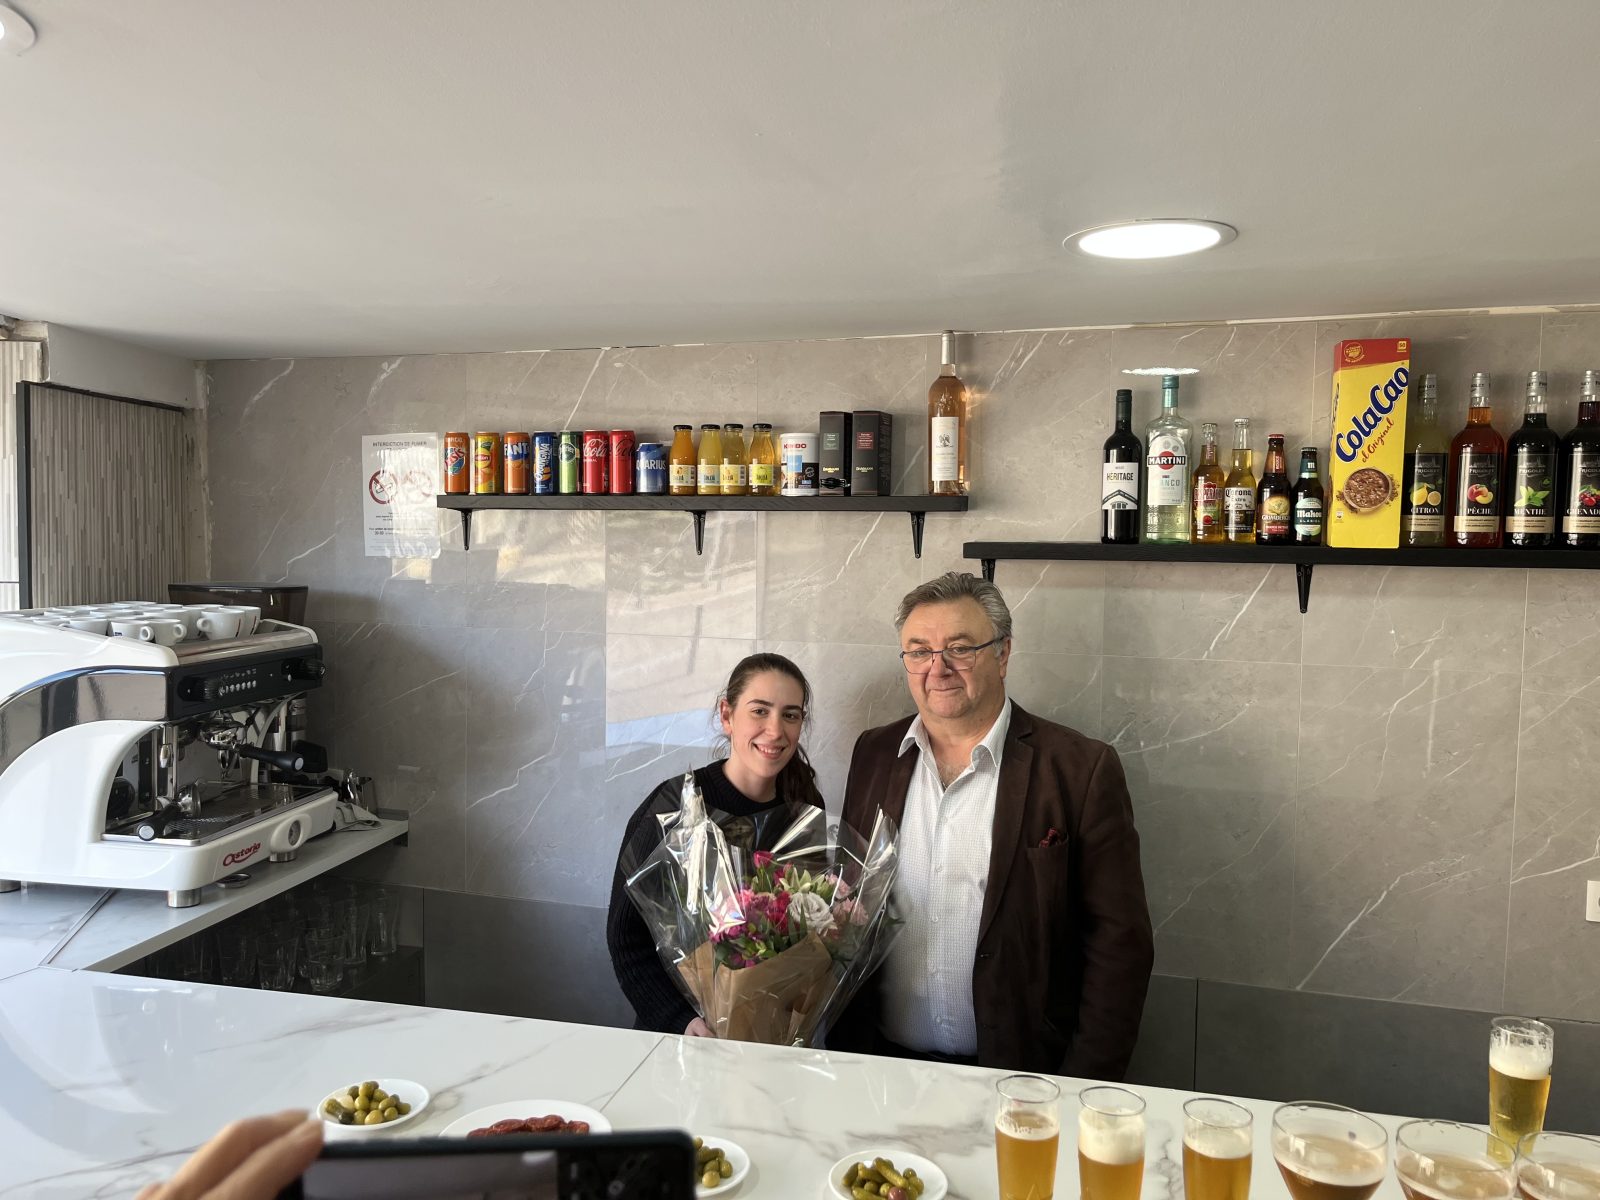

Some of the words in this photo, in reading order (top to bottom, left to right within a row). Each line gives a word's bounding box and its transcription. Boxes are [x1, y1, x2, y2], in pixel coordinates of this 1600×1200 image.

[1336, 366, 1409, 463] ColaCao
[1361, 450, 1369, 463] el
[1367, 416, 1395, 454] Original
[503, 441, 530, 458] FANT
[635, 459, 667, 471] QARIUS
[1148, 455, 1186, 466] MARTINI
[1106, 472, 1134, 481] HERITAGE
[1225, 488, 1252, 498] Corona
[1467, 506, 1492, 515] PÊCHE
[1513, 508, 1547, 516] MENTHE
[222, 842, 262, 866] Astoria
